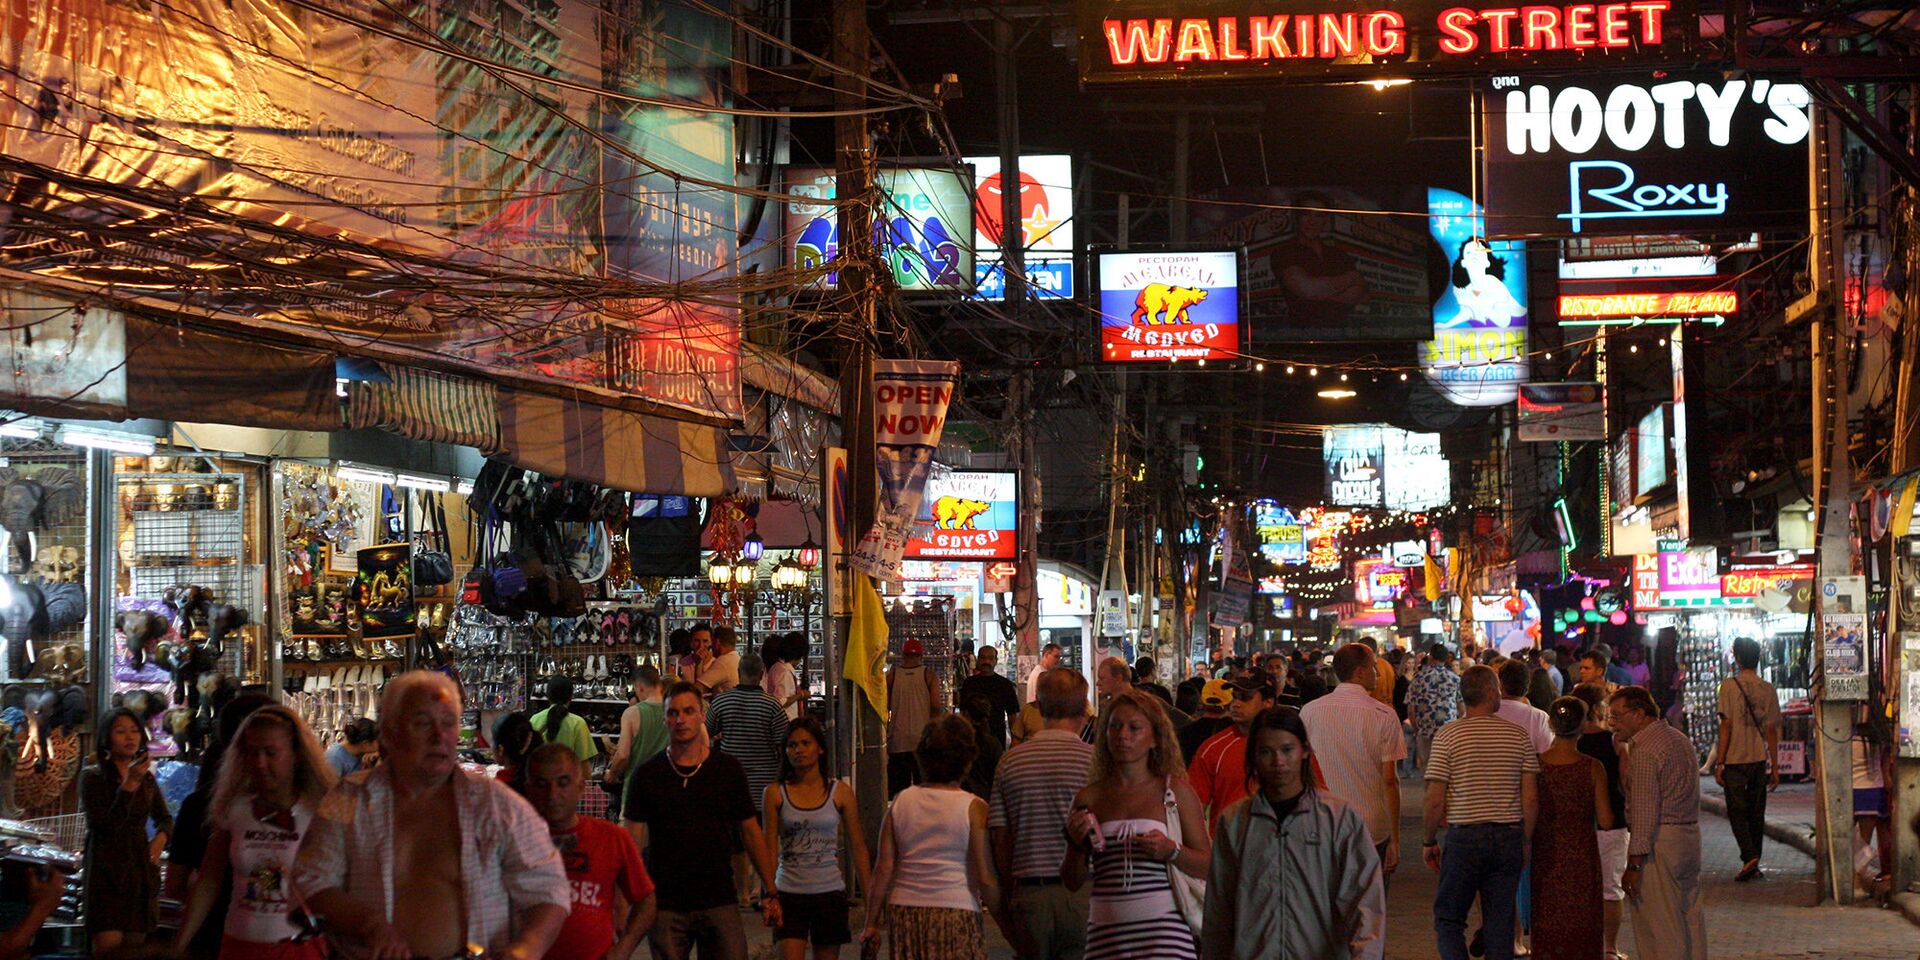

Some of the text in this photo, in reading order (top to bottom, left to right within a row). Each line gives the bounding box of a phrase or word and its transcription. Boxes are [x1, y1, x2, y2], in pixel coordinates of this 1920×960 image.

[1104, 1, 1671, 65] WALKING STREET
[1506, 79, 1810, 155] HOOTY'S
[1557, 160, 1728, 232] Roxy
[1561, 294, 1736, 316] RISTORANTE ITALIANO
[1131, 348, 1210, 358] RESTAURANT
[1423, 331, 1525, 362] SIMON
[1441, 366, 1516, 382] BEER BAR
[877, 385, 950, 405] OPEN
[877, 414, 943, 435] NOW
[920, 548, 997, 556] RESTAURANT
